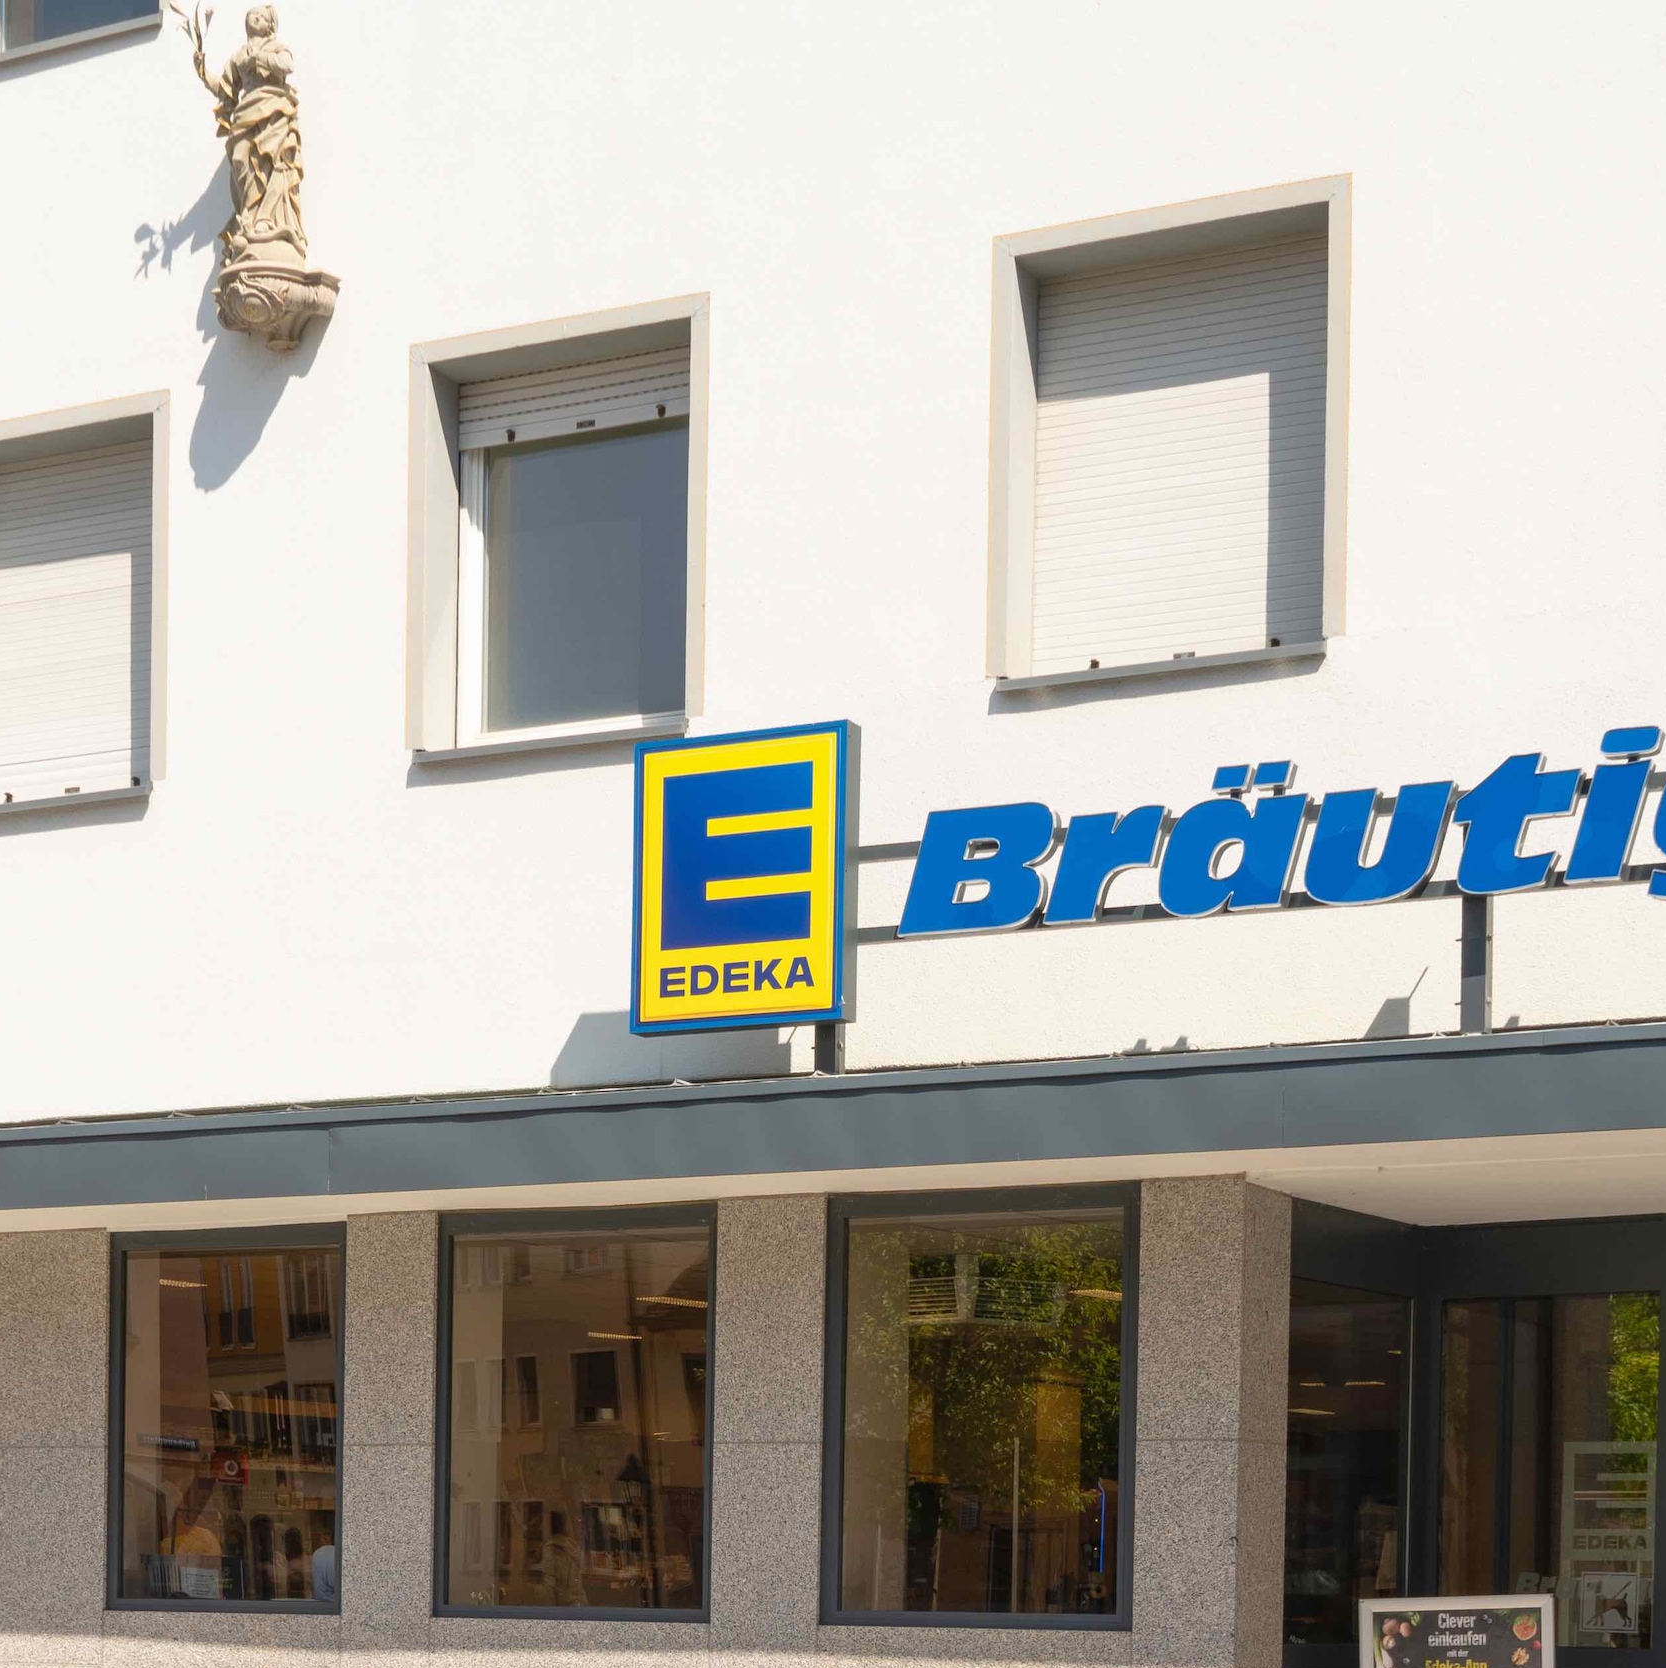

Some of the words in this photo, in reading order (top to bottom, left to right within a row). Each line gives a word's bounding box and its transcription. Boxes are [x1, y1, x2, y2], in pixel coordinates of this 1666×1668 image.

[659, 956, 815, 999] EDEKA
[1573, 1535, 1647, 1549] EDEKA
[1438, 1613, 1477, 1629] Clever
[1428, 1631, 1487, 1647] einkaufen
[1447, 1650, 1457, 1658] mit
[1458, 1649, 1469, 1658] der
